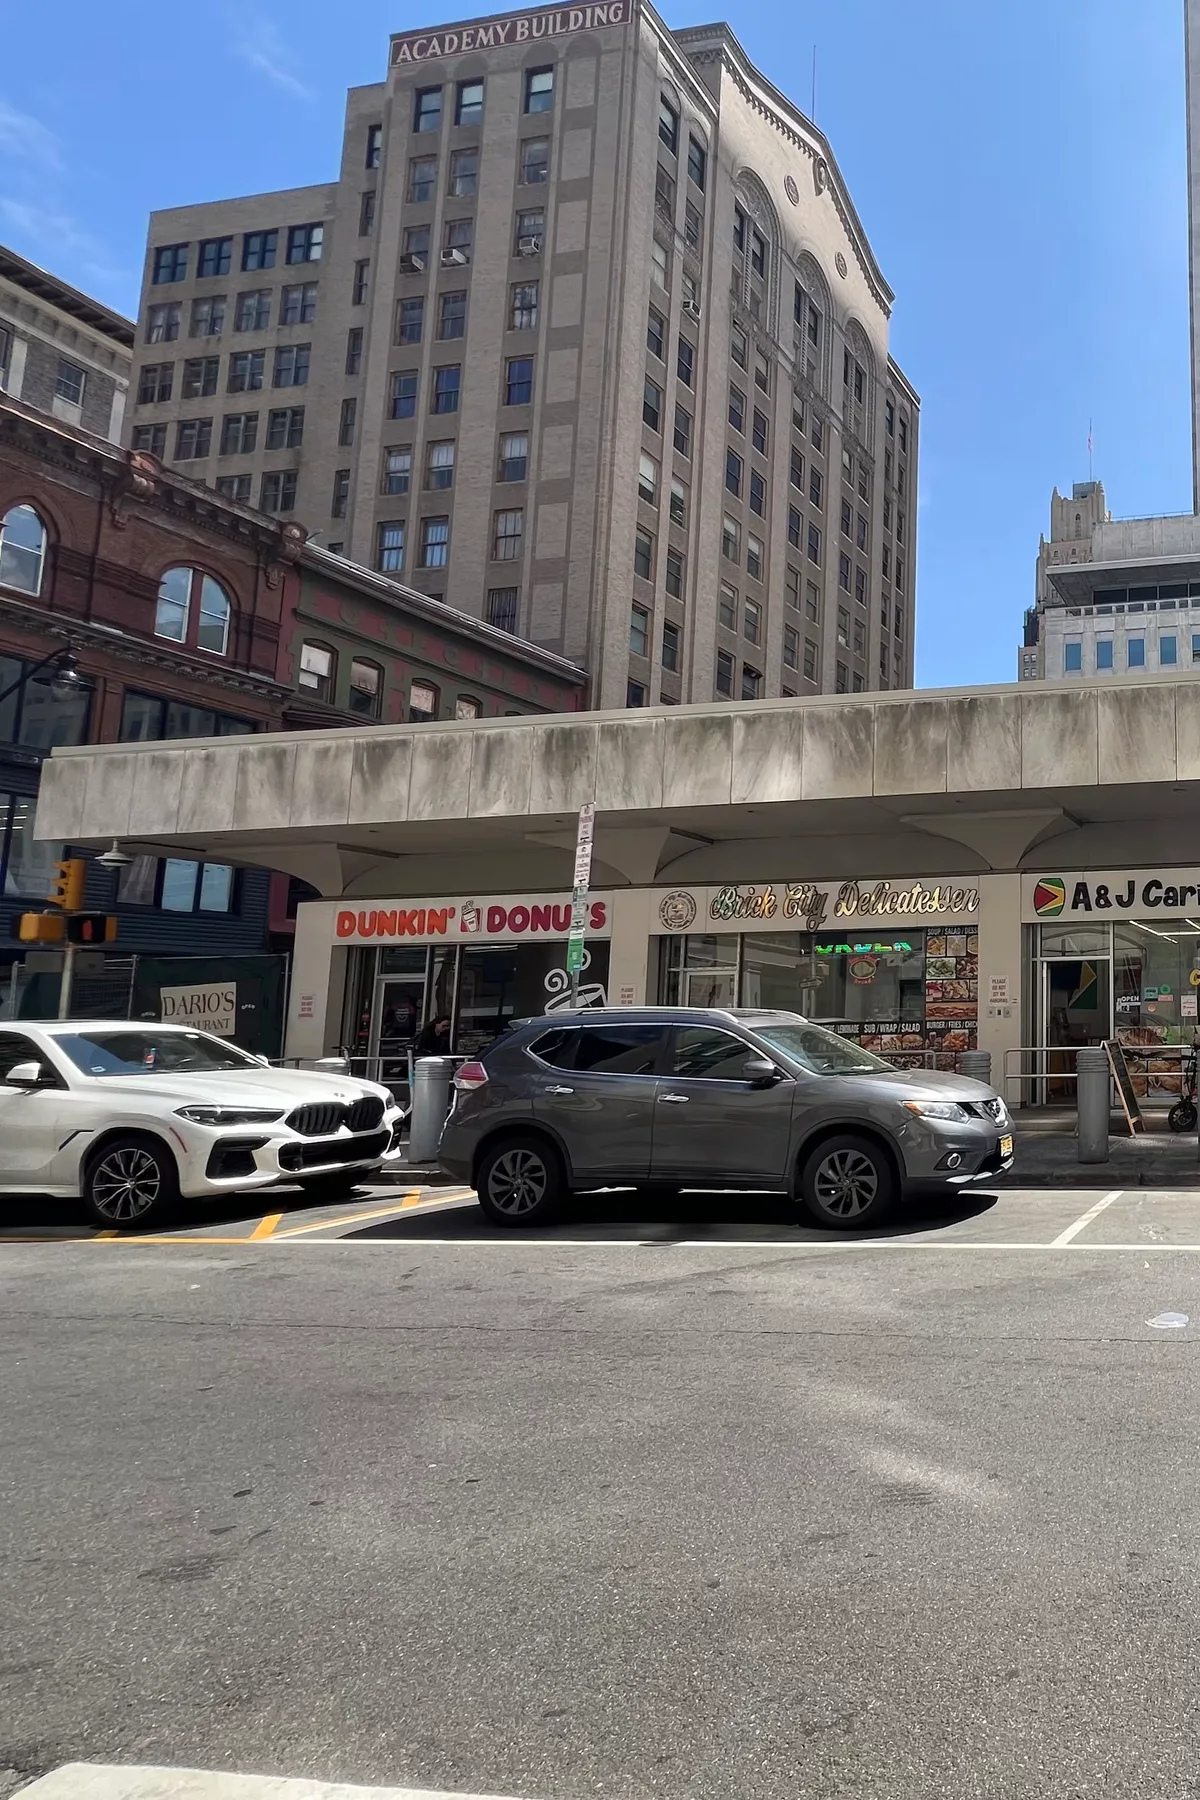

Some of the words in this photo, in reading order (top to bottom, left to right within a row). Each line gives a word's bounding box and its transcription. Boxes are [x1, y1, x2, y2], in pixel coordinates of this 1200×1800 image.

[396, 23, 511, 64] ACADEMY
[515, 2, 624, 42] BUILDING
[710, 884, 778, 921] Brick
[782, 882, 828, 932] City
[833, 880, 980, 918] Delicatessen
[1071, 880, 1136, 912] A&J
[336, 905, 455, 938] DUNKIN'
[487, 901, 607, 934] DONUS
[163, 991, 235, 1016] DARIO'S
[863, 1023, 876, 1033] SUB
[879, 1023, 897, 1033] WRAP
[901, 1023, 921, 1033] SALAD
[926, 1021, 946, 1029] BURGER
